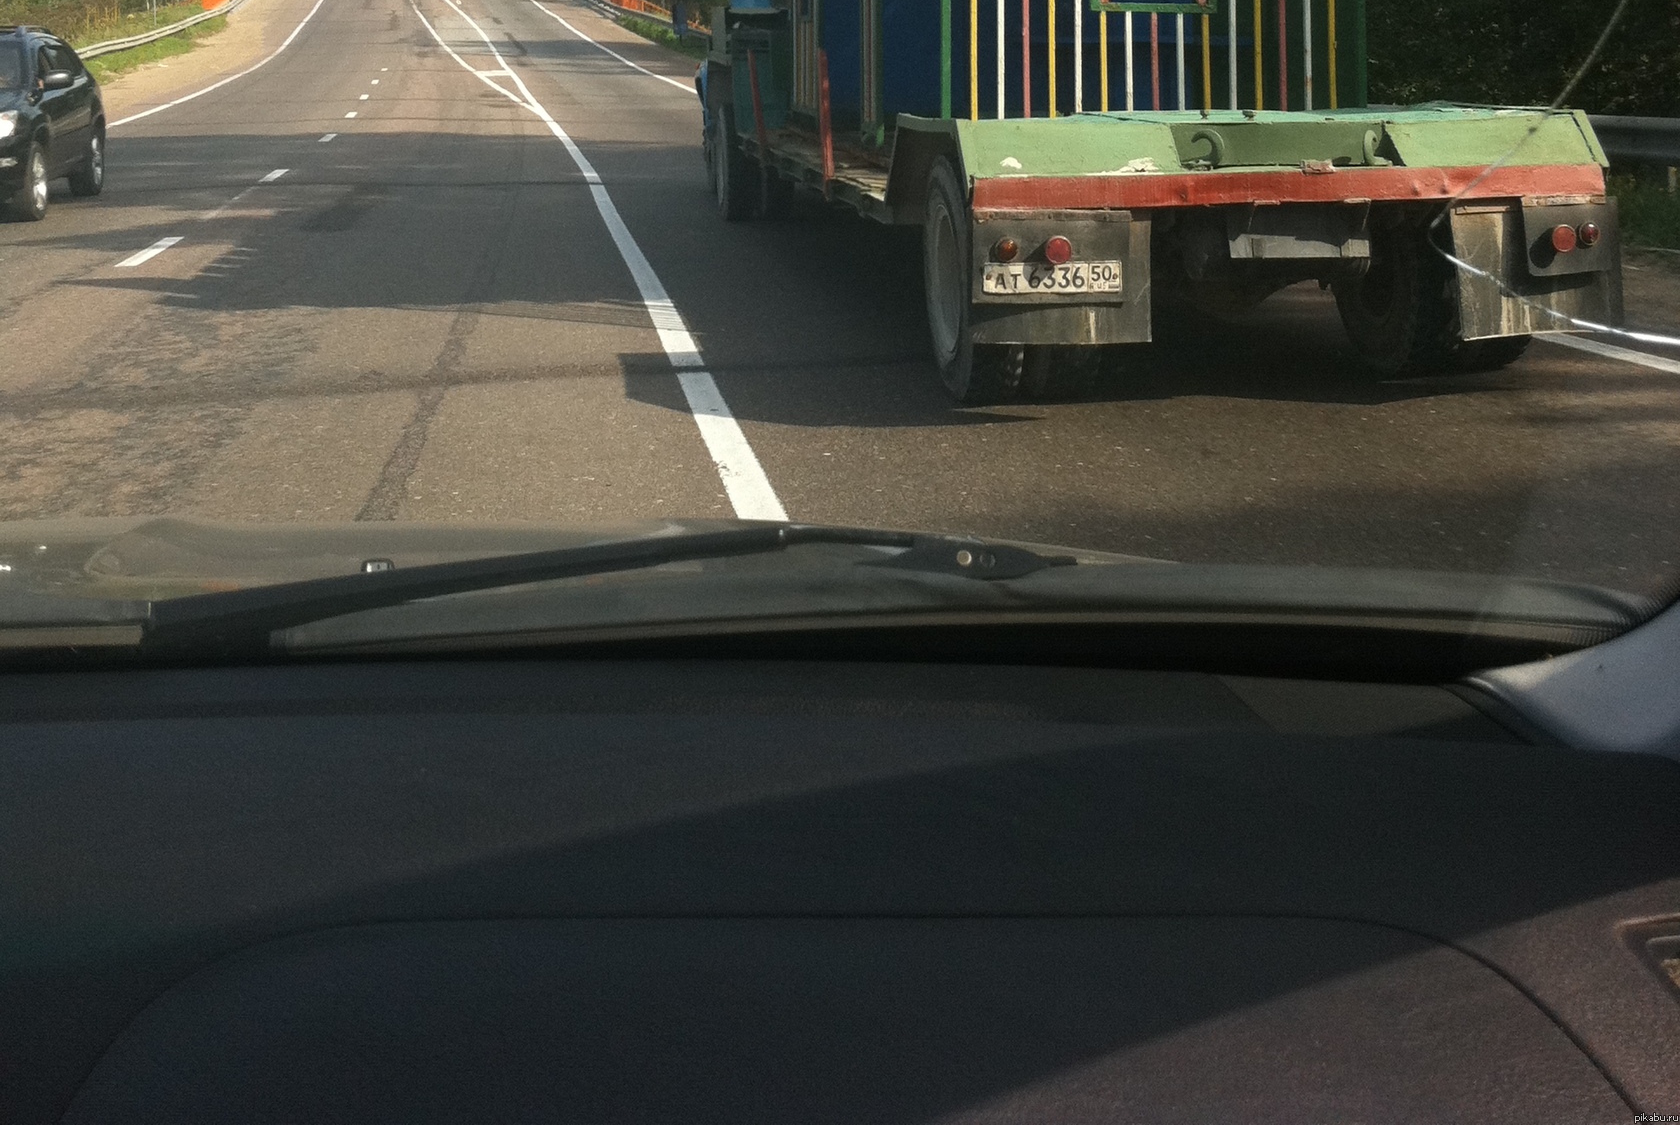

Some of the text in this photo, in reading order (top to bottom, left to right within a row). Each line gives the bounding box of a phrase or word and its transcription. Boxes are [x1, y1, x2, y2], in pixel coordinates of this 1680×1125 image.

[994, 265, 1112, 290] АТ 6336 50
